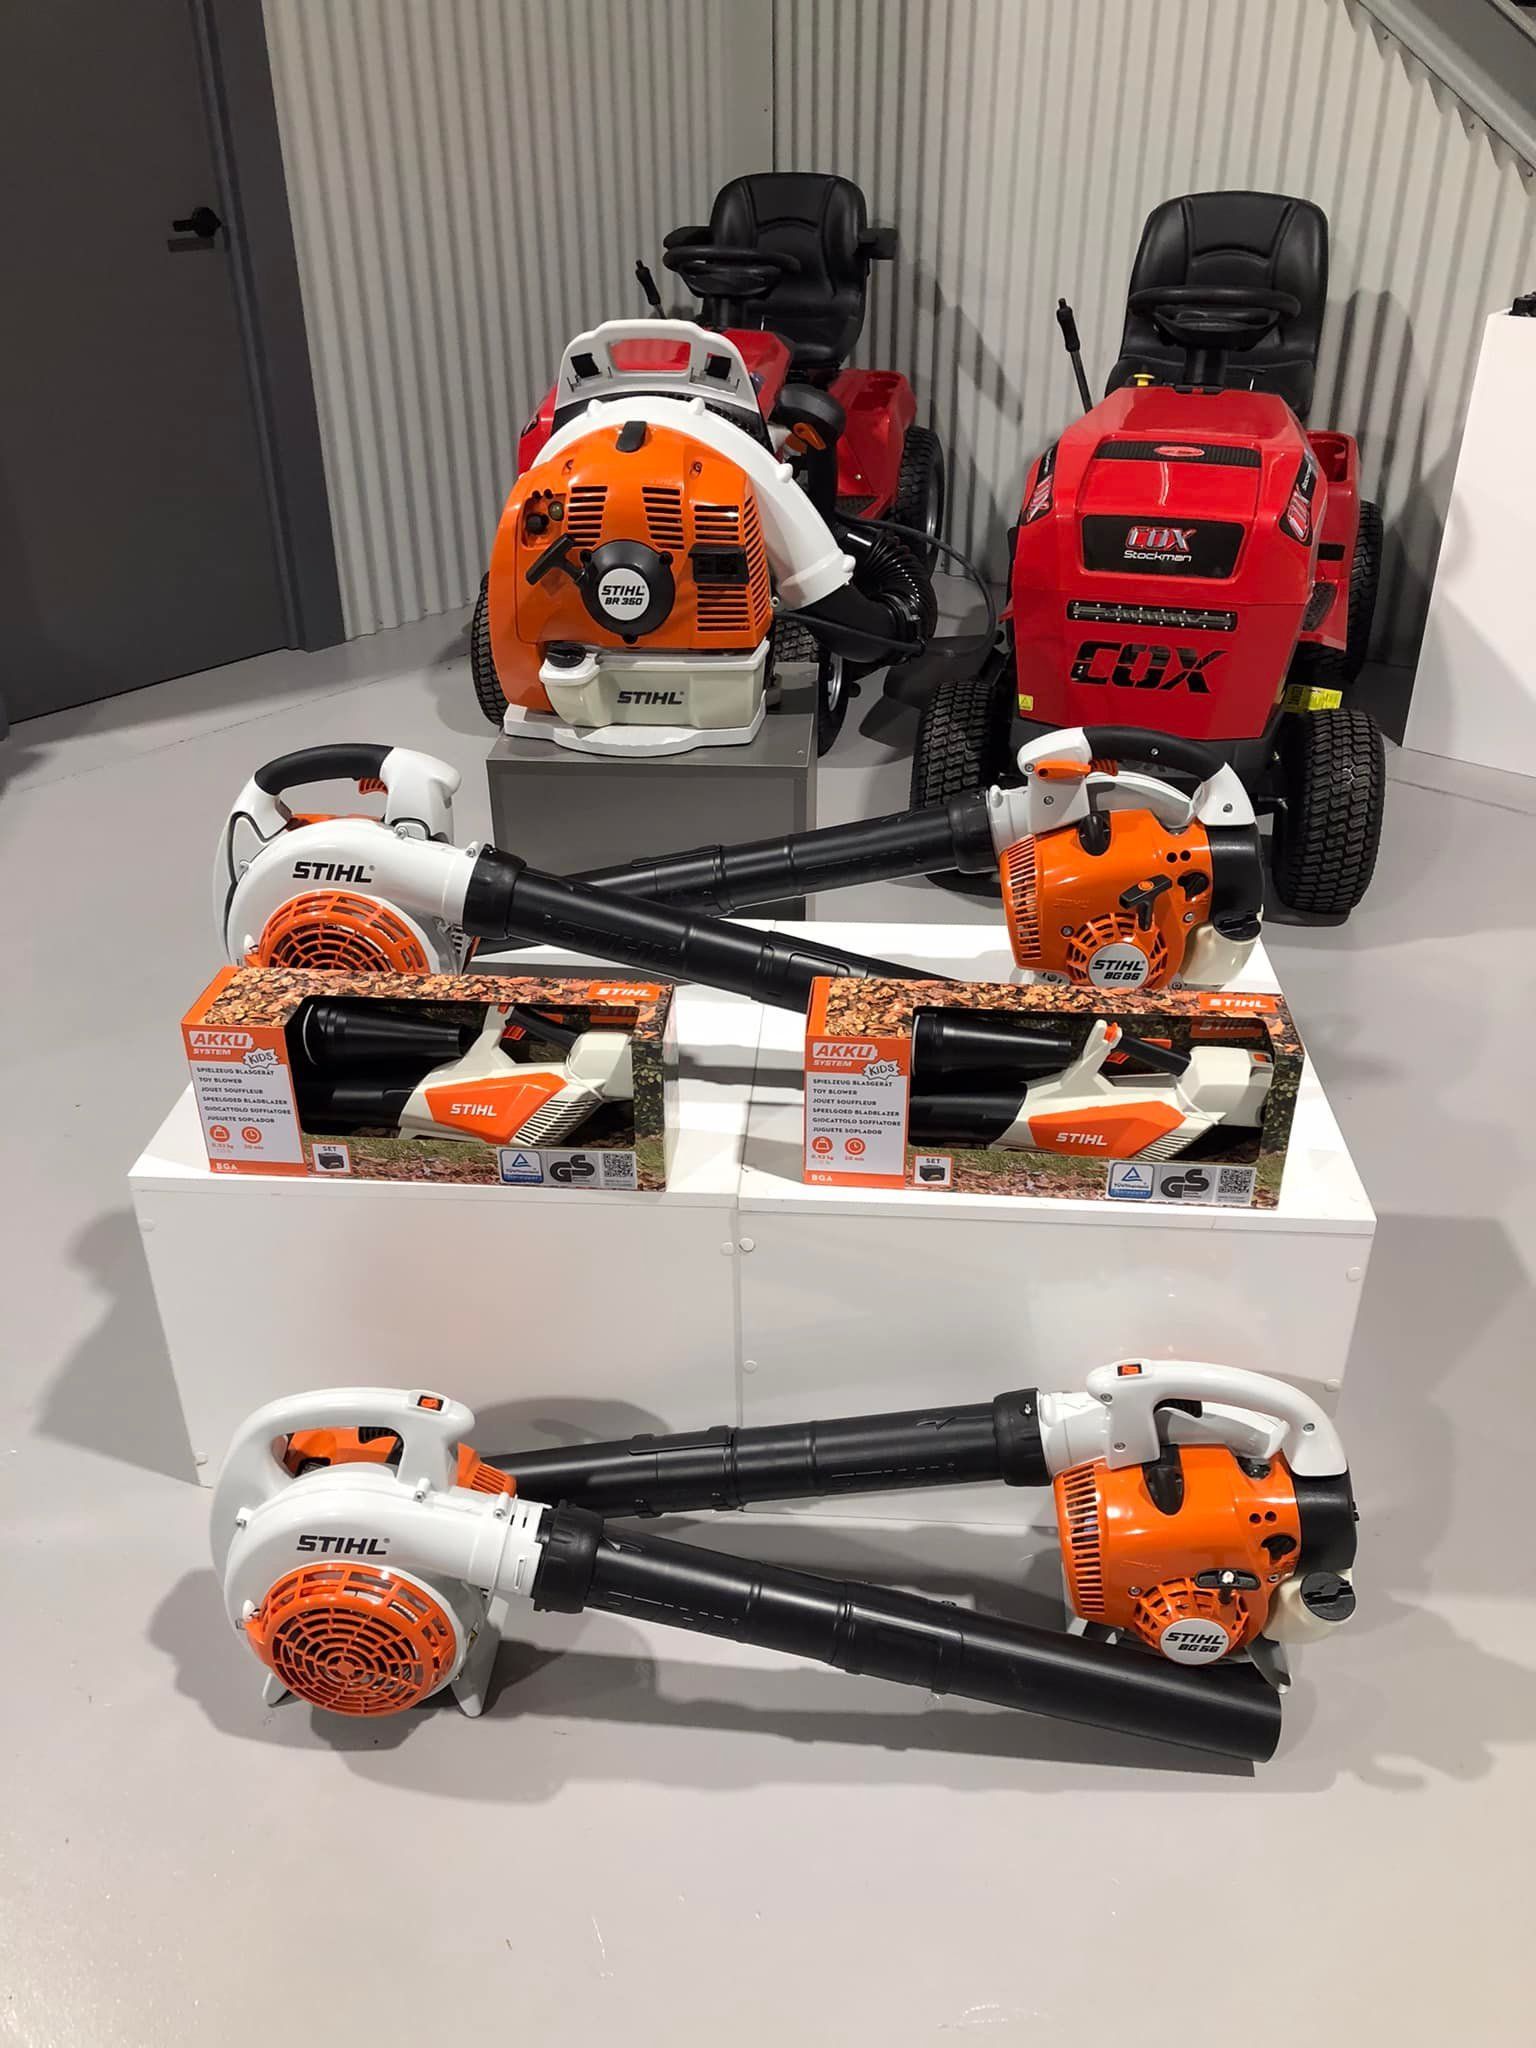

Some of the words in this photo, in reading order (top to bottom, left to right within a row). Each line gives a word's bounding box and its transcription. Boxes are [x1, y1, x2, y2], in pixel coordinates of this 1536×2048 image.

[1125, 526, 1197, 552] COX
[1123, 550, 1192, 562] Stockman
[601, 585, 645, 596] STIHL
[605, 597, 620, 605] BR
[1070, 640, 1228, 694] COX
[617, 690, 682, 705] STIHL
[292, 861, 372, 883] STIHL
[1092, 959, 1144, 971] STIHL
[596, 987, 651, 997] STIHL
[1209, 999, 1268, 1008] STIHL
[194, 1033, 248, 1046] AKKU
[815, 1045, 873, 1058] AKKU
[248, 1052, 273, 1064] KIDS
[868, 1064, 895, 1076] KIDS
[450, 1103, 497, 1117] STIHL
[1055, 1132, 1108, 1146] STIHL
[215, 1162, 238, 1170] BGA
[811, 1174, 833, 1182] BGA
[296, 1534, 387, 1555] STIHL
[1165, 1632, 1224, 1645] STIHL
